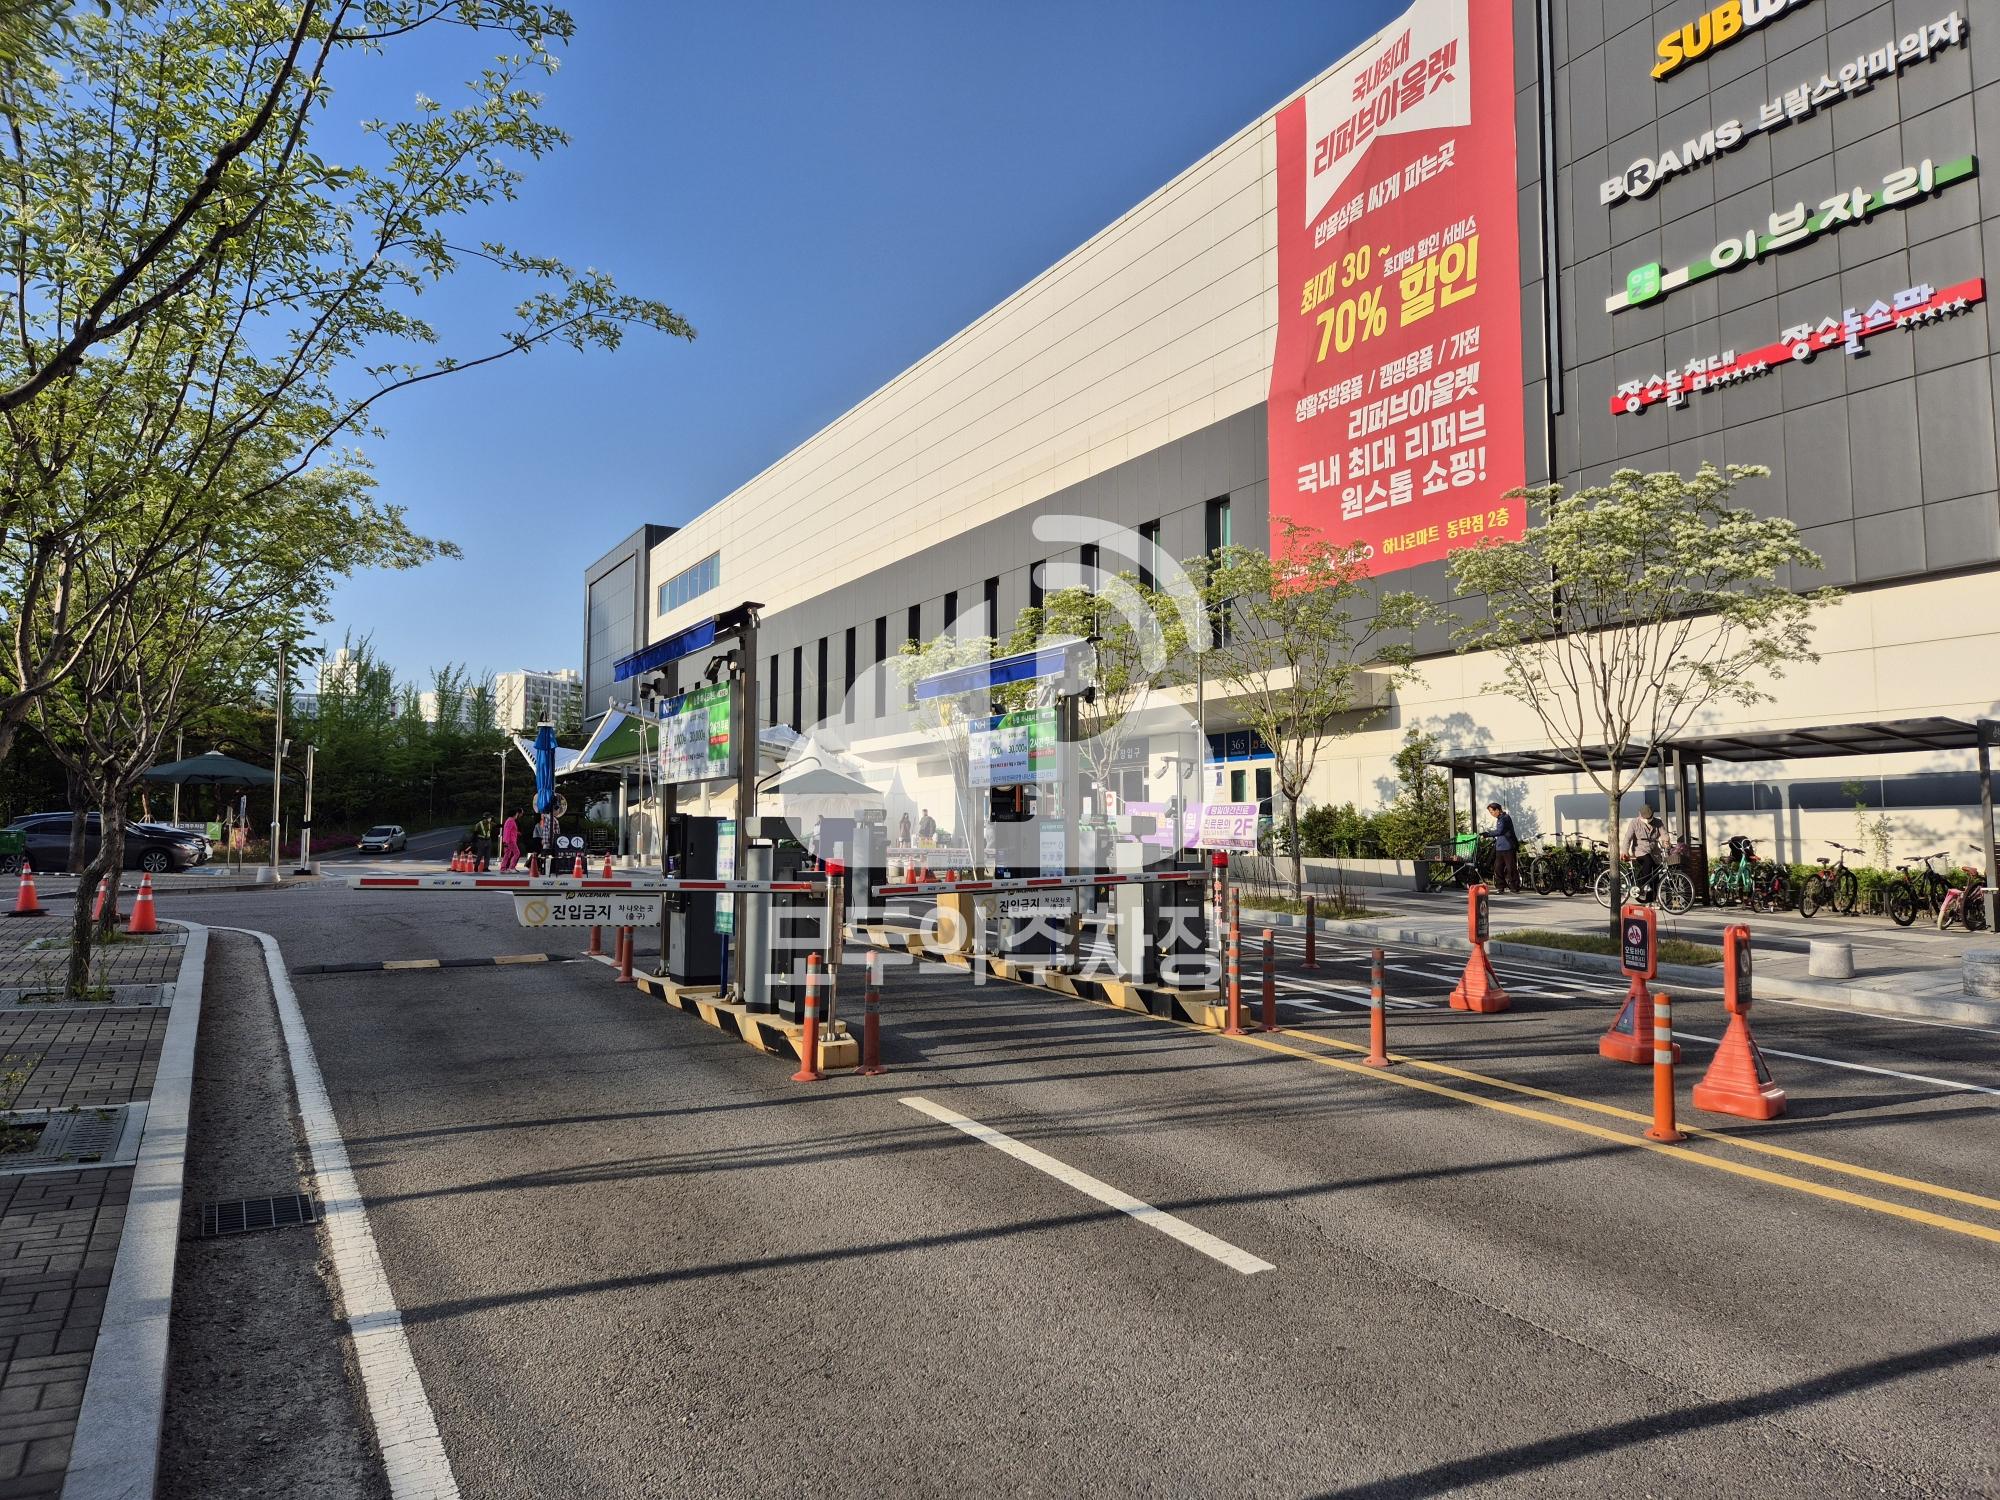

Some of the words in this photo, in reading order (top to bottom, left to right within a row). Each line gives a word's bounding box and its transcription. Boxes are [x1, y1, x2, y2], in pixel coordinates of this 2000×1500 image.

[1352, 28, 1411, 102] 국내최대
[1651, 0, 1810, 78] SUBW
[1314, 38, 1458, 178] 리퍼브아울렛
[1600, 120, 1744, 205] BRAMS
[1758, 11, 1968, 130] 브람스안마의자
[1314, 192, 1364, 249] 반품상품
[1367, 171, 1400, 212] 싸게
[1404, 139, 1455, 192] 파는곳
[1710, 158, 1934, 269] 이브자리
[1301, 260, 1337, 316] 최대
[1341, 245, 1371, 288] 30
[1384, 245, 1415, 278] 초대박
[1418, 232, 1439, 260] 할인
[1442, 215, 1476, 247] 서비스
[1316, 285, 1387, 363] 70%
[1400, 234, 1479, 328] 할인
[1295, 374, 1363, 422] 생활주방용품
[1380, 345, 1433, 390] 캠핑용품
[1450, 326, 1480, 360] 가전
[1617, 350, 1735, 412] 장수돌침대
[1781, 283, 1936, 359] 장수돌소파
[1348, 361, 1480, 440] 리퍼브아울렛
[1297, 454, 1340, 493] 국내
[1348, 434, 1395, 479] 최대
[1405, 404, 1486, 461] 리퍼브
[1341, 468, 1413, 521] 원스톱
[1422, 446, 1486, 496] 쇼핑!
[1382, 525, 1439, 554] 하나로마트
[1446, 514, 1484, 540] 동탄점
[1488, 507, 1509, 529] 2층
[974, 720, 986, 730] NH
[1231, 739, 1245, 750] 365
[1234, 818, 1254, 836] 2F
[552, 904, 612, 920] 진입금지
[626, 904, 646, 912] 나오는
[647, 904, 654, 912] 곳
[999, 897, 1040, 913] 진입금지
[1624, 946, 1646, 955] 오토바이
